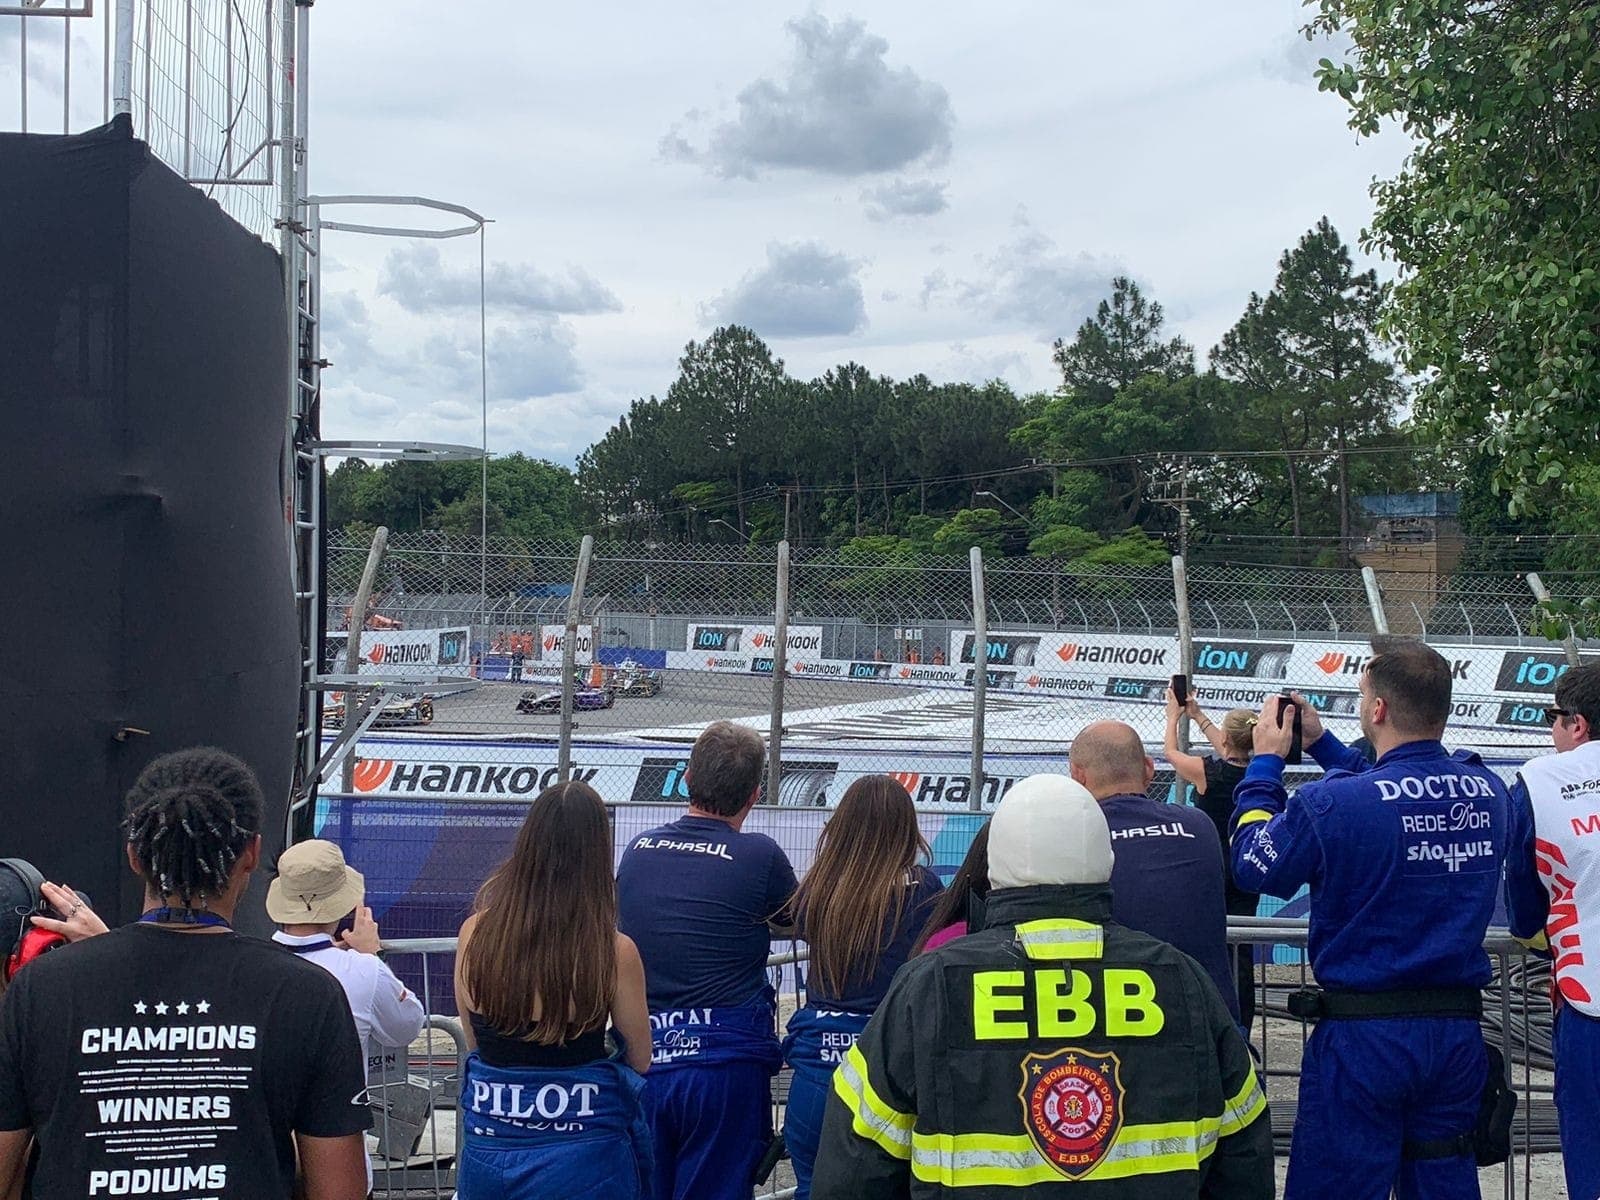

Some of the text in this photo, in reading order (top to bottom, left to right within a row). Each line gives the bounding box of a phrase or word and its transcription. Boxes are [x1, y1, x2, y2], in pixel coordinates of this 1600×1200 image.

[1374, 774, 1496, 801] DOCTOR
[1401, 801, 1491, 833] REDE D'OR
[633, 837, 733, 861] ALPHASUL
[973, 968, 1165, 1040] EBB
[81, 1025, 257, 1054] CHAMPIONS
[1043, 1066, 1102, 1086] BOMBEIROS
[471, 1079, 599, 1119] PILOT
[1034, 1087, 1046, 1099] DE
[1100, 1087, 1112, 1101] DO
[97, 1095, 231, 1124] WINNERS
[1032, 1104, 1057, 1143] ESCOLA
[1092, 1105, 1113, 1142] BRASIL
[89, 1164, 227, 1196] PODIUMS
